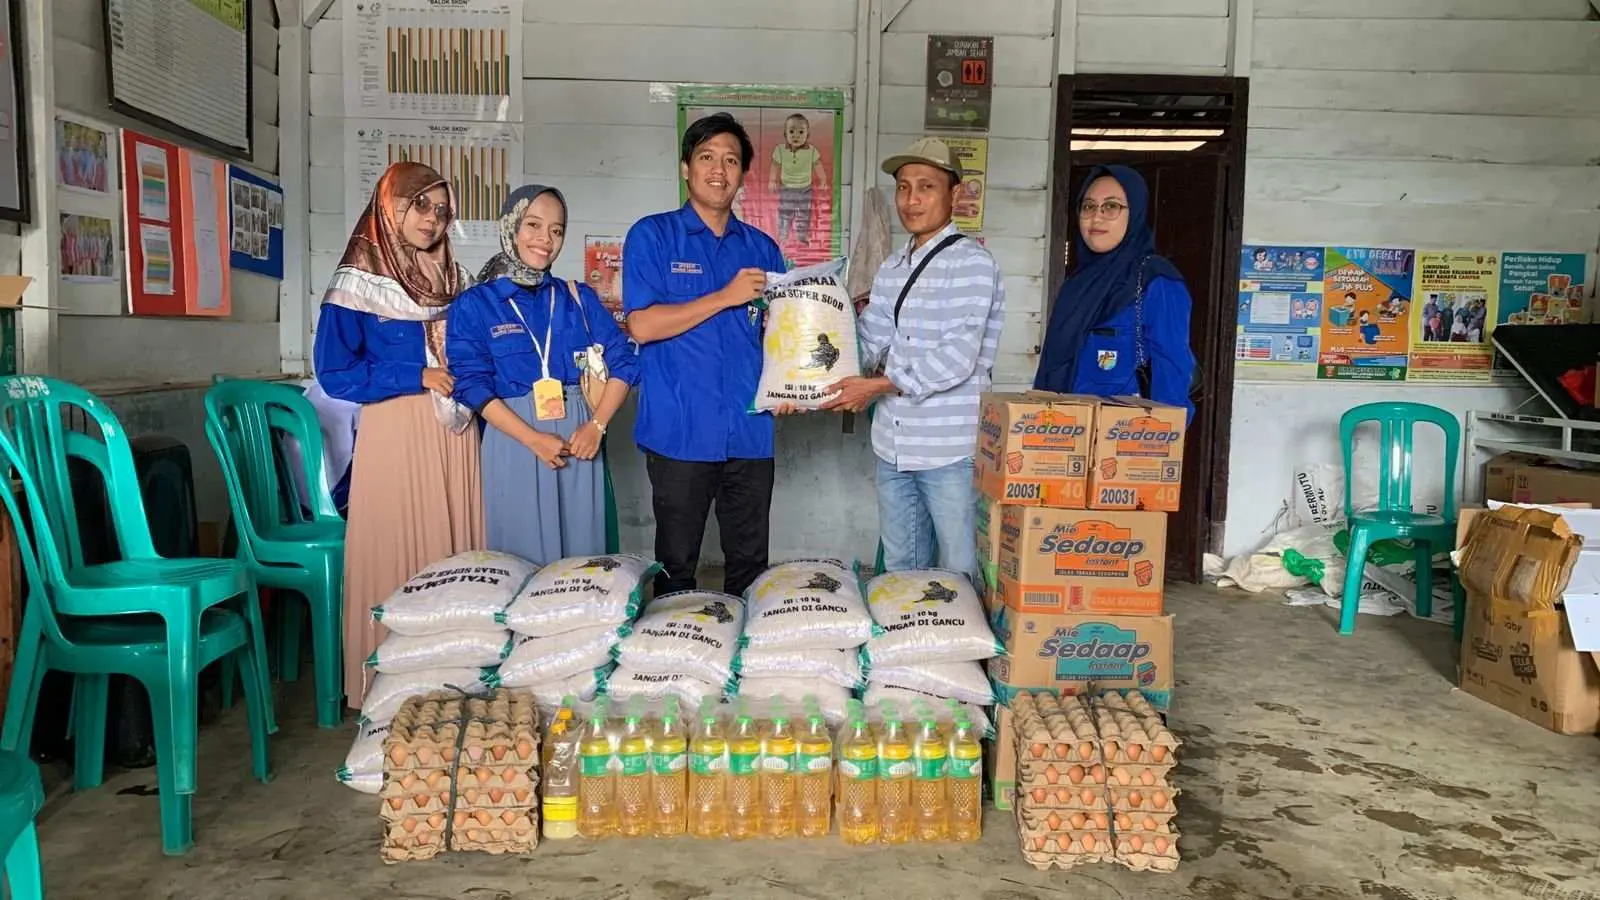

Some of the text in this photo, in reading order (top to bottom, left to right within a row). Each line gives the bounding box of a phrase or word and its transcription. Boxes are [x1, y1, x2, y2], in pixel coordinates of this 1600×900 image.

[1504, 255, 1562, 264] Perilaku Hidup
[1508, 270, 1538, 278] Pangkal
[788, 288, 819, 302] SUPER
[821, 294, 844, 311] SUOH
[766, 391, 797, 400] JANGAN
[1010, 421, 1085, 438] Sedaap
[1105, 427, 1181, 444] Sedaap
[1073, 461, 1081, 473] 9
[1166, 467, 1175, 478] 9
[1007, 484, 1041, 499] 20031
[1060, 482, 1083, 498] 40
[1100, 489, 1136, 505] 20031
[1155, 487, 1176, 503] 40
[1053, 524, 1078, 534] Mie
[1039, 535, 1144, 558] Sedaap
[403, 576, 458, 593] SEMAR
[530, 586, 566, 597] JANGAN
[762, 605, 799, 618] JANGAN
[815, 604, 848, 613] GANCU
[693, 625, 703, 633] kg
[884, 620, 915, 632] ANGAN
[1053, 627, 1079, 638] Mie
[641, 628, 723, 649] JANGAN DI GANCU
[1038, 639, 1150, 663] Sedaap
[632, 673, 669, 682] JANGAN
